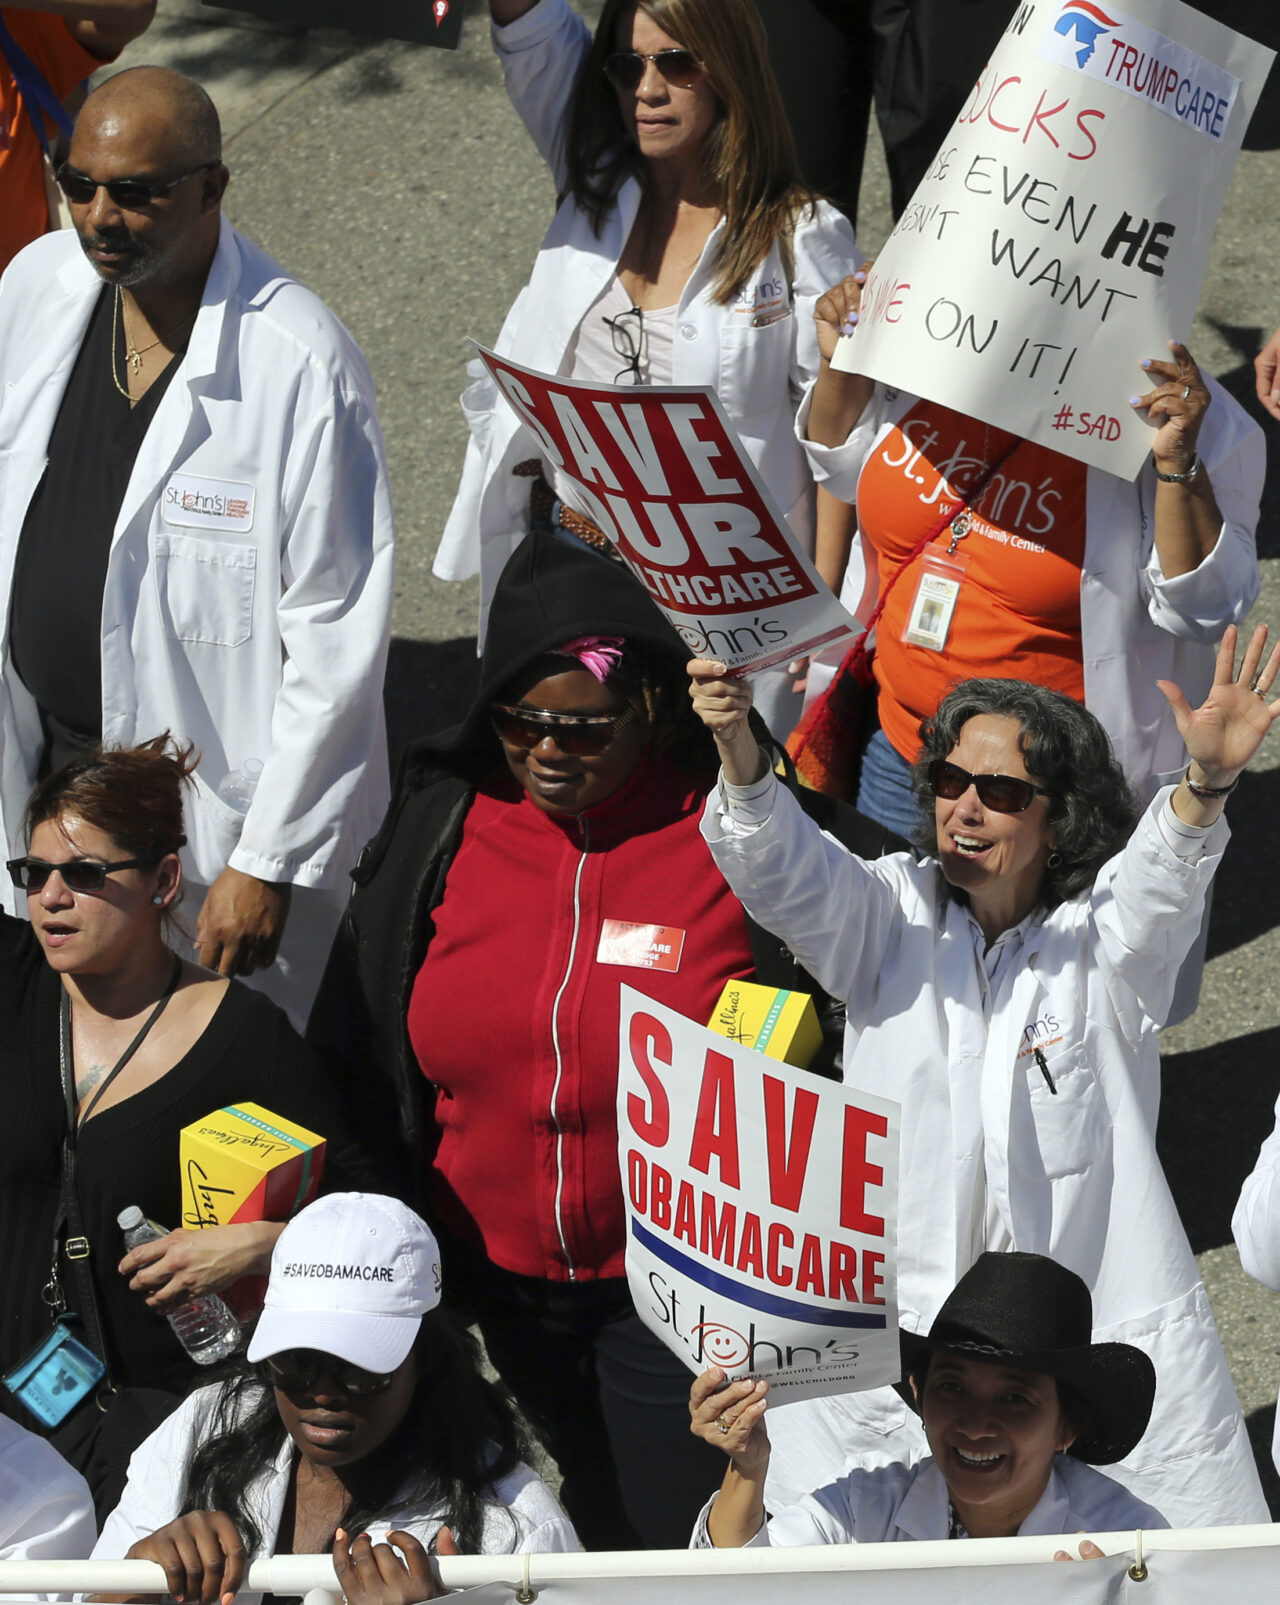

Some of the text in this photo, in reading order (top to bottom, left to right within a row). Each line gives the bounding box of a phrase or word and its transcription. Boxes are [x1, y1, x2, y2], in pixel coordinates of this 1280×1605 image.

[1105, 38, 1229, 138] TRUMPCARE
[964, 155, 1098, 244] EVEN
[1100, 210, 1176, 277] HE
[990, 228, 1138, 322] WANT
[925, 296, 998, 354] ON
[1008, 338, 1078, 396] IT!
[495, 367, 745, 497] SAVE
[881, 419, 940, 485] St.
[1051, 403, 1122, 442] #SAD
[166, 486, 181, 506] St.
[181, 489, 223, 512] John's
[984, 525, 1011, 546] Family
[632, 564, 804, 607] LTHCARE
[626, 1010, 889, 1238] SAVE
[283, 1263, 395, 1283] #SAVEOBAMACARE
[627, 1148, 887, 1307] OBAMACARE
[648, 1271, 860, 1373] St. John's
